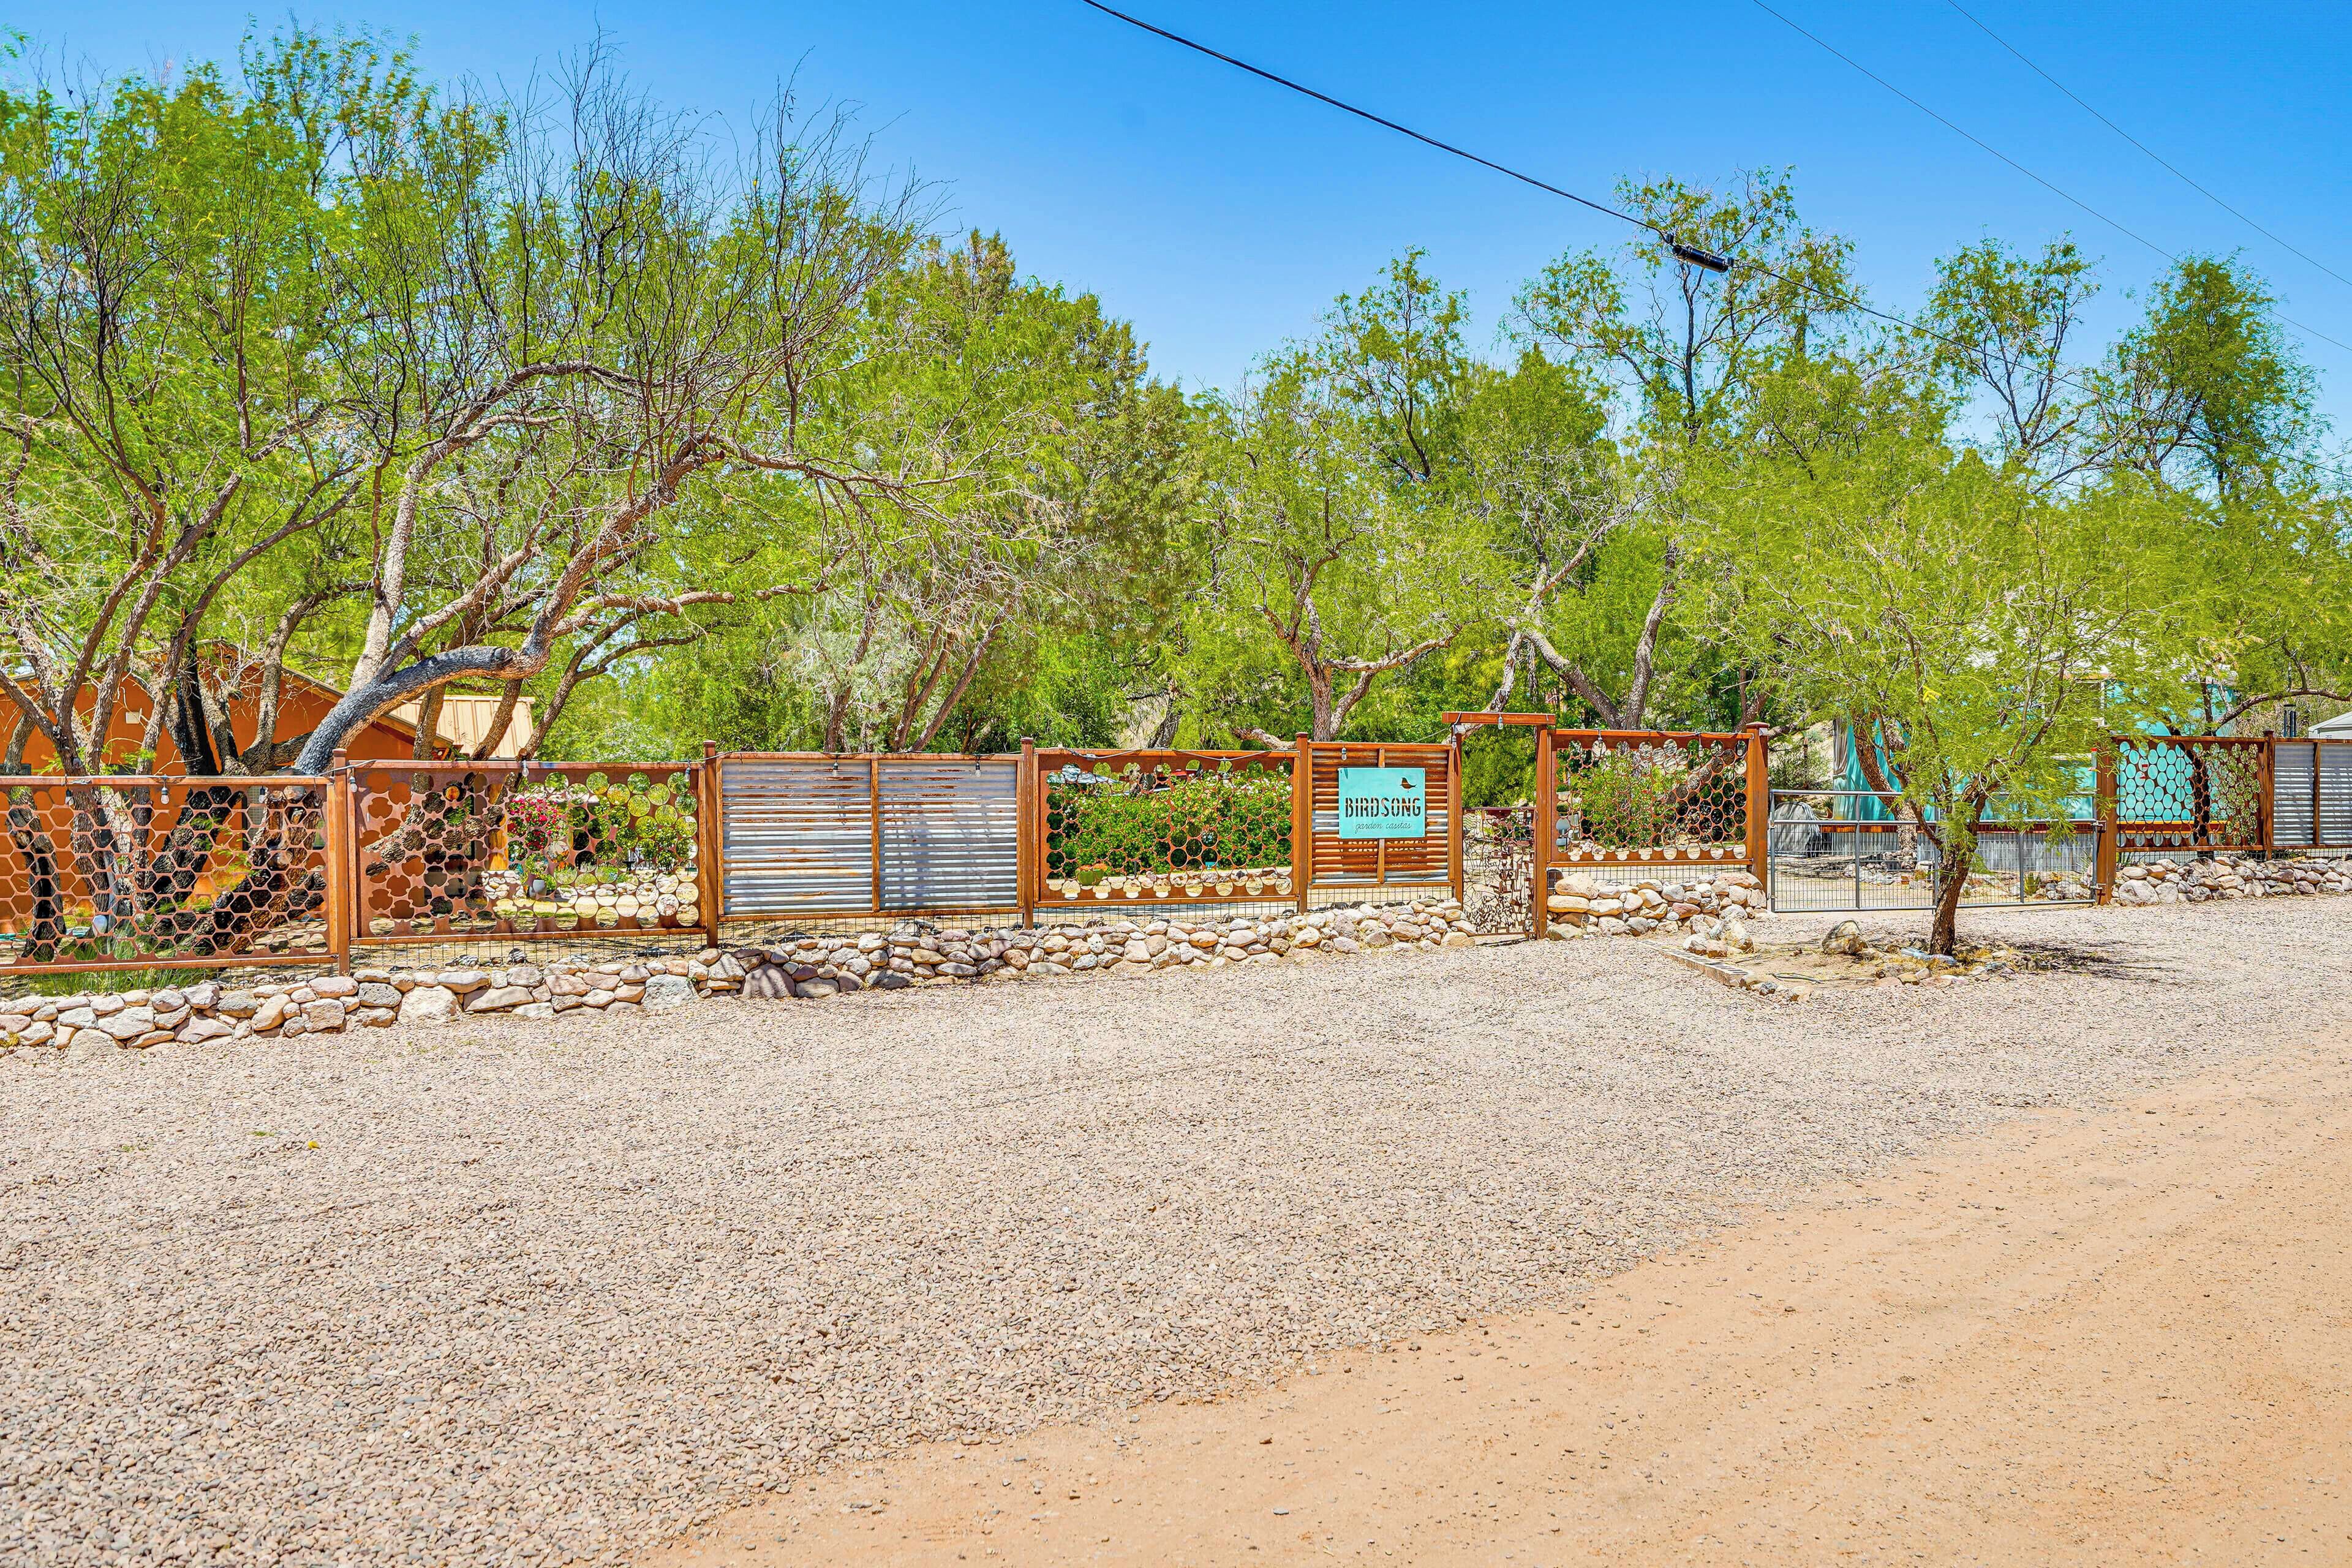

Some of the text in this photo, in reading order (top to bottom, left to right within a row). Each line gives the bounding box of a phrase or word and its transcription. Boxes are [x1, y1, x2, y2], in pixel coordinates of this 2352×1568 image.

[1345, 797, 1421, 818] BIRDSONG
[1355, 821, 1412, 834] garden casitas
